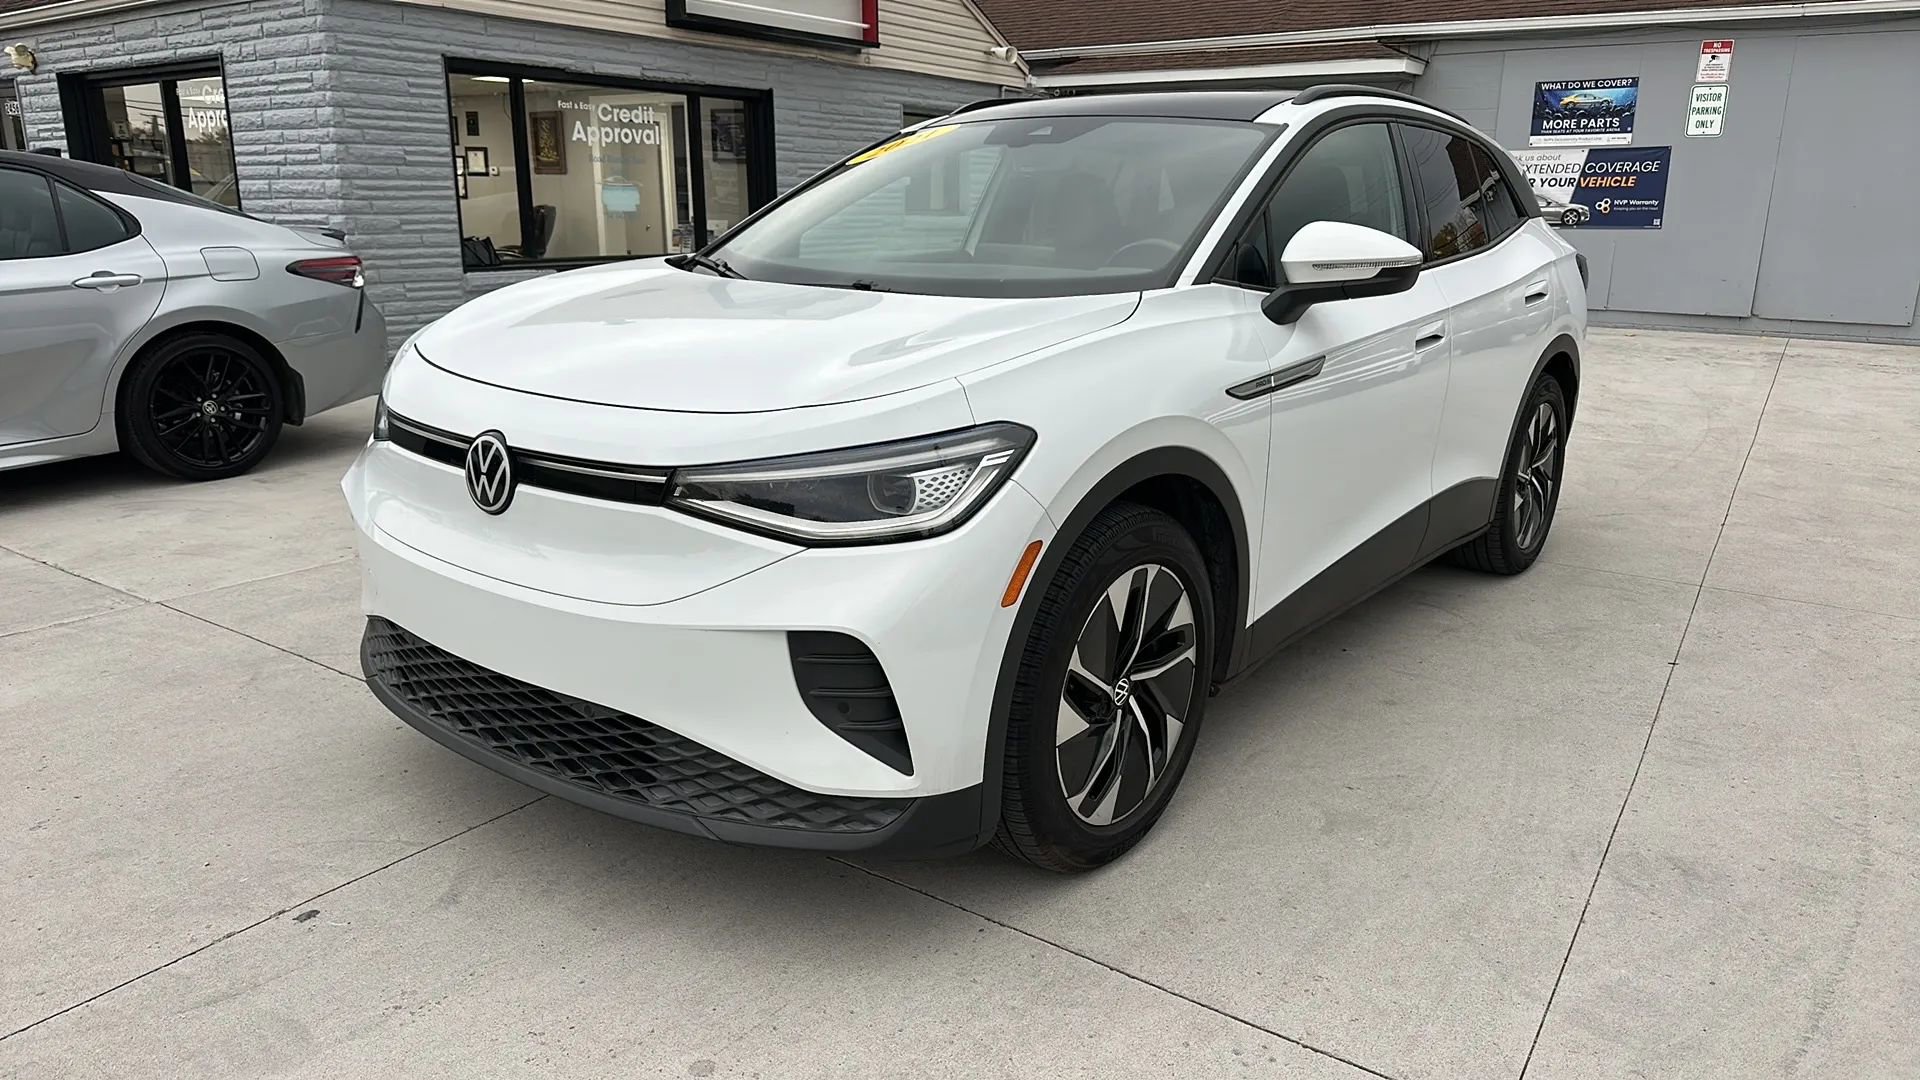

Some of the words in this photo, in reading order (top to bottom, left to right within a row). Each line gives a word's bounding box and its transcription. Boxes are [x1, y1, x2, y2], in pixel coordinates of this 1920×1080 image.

[1541, 82, 1566, 90] WHAT
[1568, 81, 1580, 89] DO
[1597, 79, 1632, 87] COVER?
[202, 85, 226, 104] Cre
[1696, 93, 1722, 102] VISITOR
[557, 100, 573, 109] Fast
[598, 103, 655, 124] Credit
[1692, 106, 1722, 115] PARKING
[188, 107, 228, 132] Appro
[1542, 119, 1577, 129] MORE
[1580, 118, 1620, 128] PARTS
[1695, 120, 1715, 128] ONLY
[572, 121, 660, 147] Approval
[1522, 163, 1582, 174] XTENDED
[1584, 160, 1661, 173] COVERAGE
[1540, 178, 1576, 188] YOUR
[1580, 176, 1637, 188] VEHICLE
